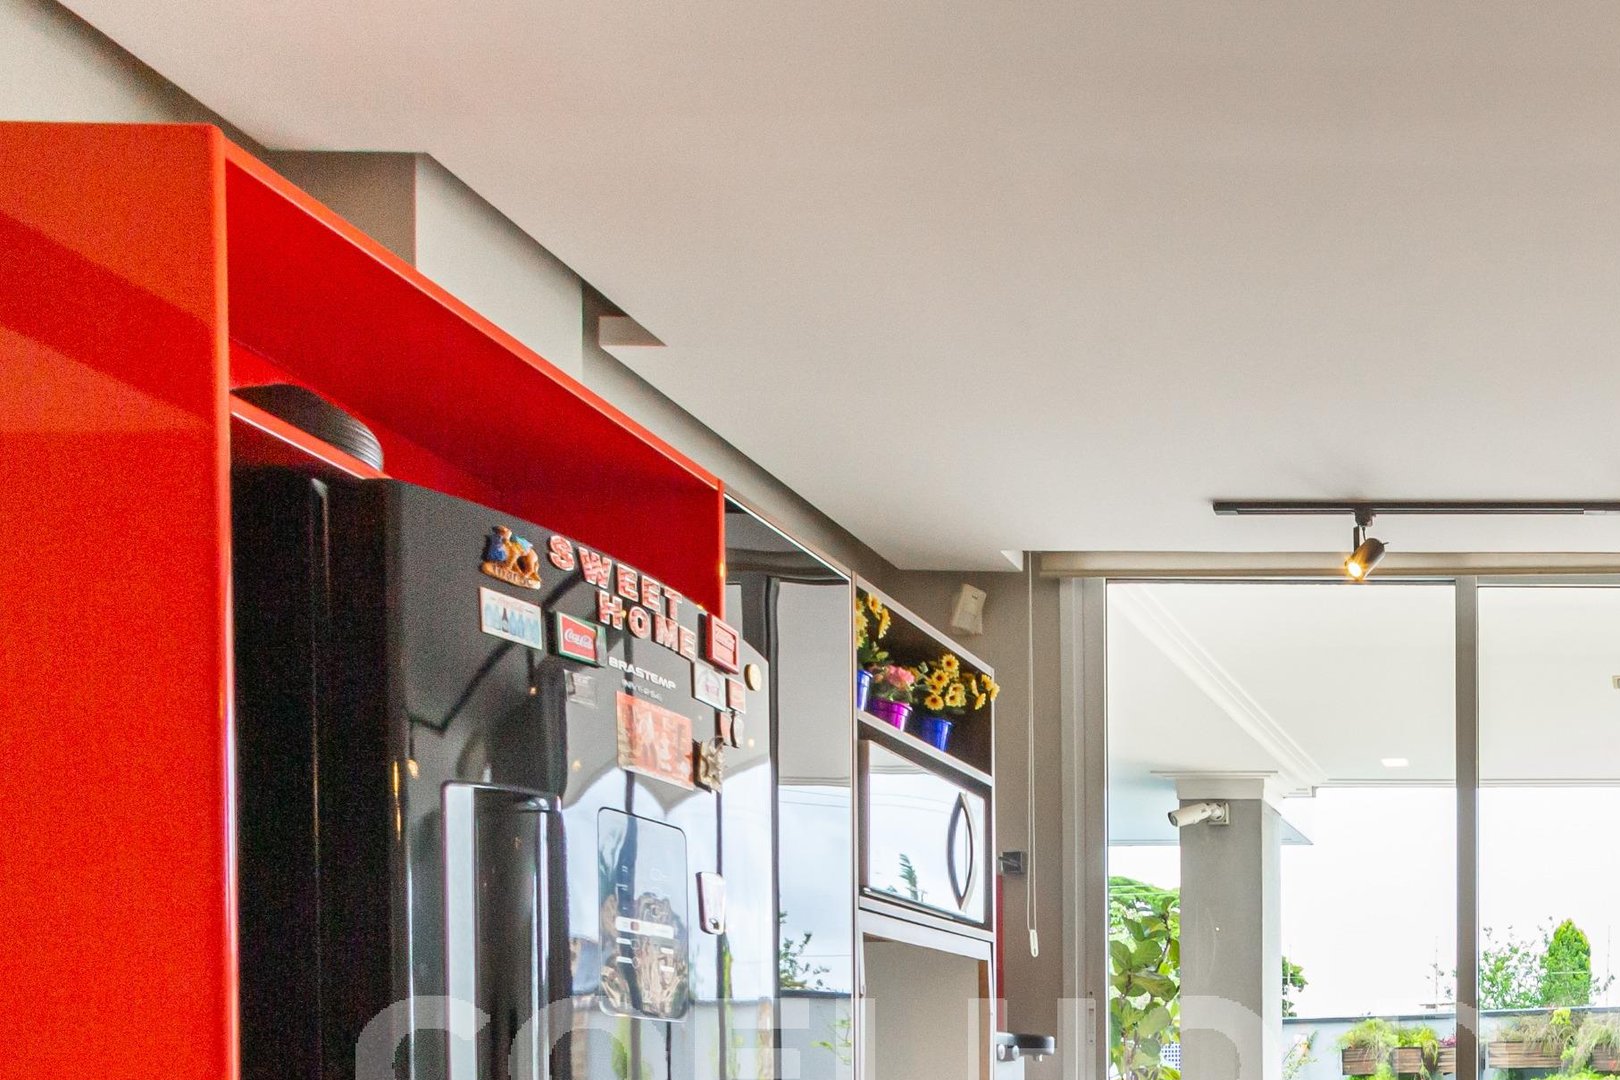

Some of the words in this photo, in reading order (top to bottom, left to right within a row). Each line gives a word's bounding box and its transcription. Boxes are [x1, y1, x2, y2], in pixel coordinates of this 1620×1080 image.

[549, 534, 682, 620] SWEET
[599, 590, 697, 662] HOME
[608, 656, 677, 690] BRASTEMP
